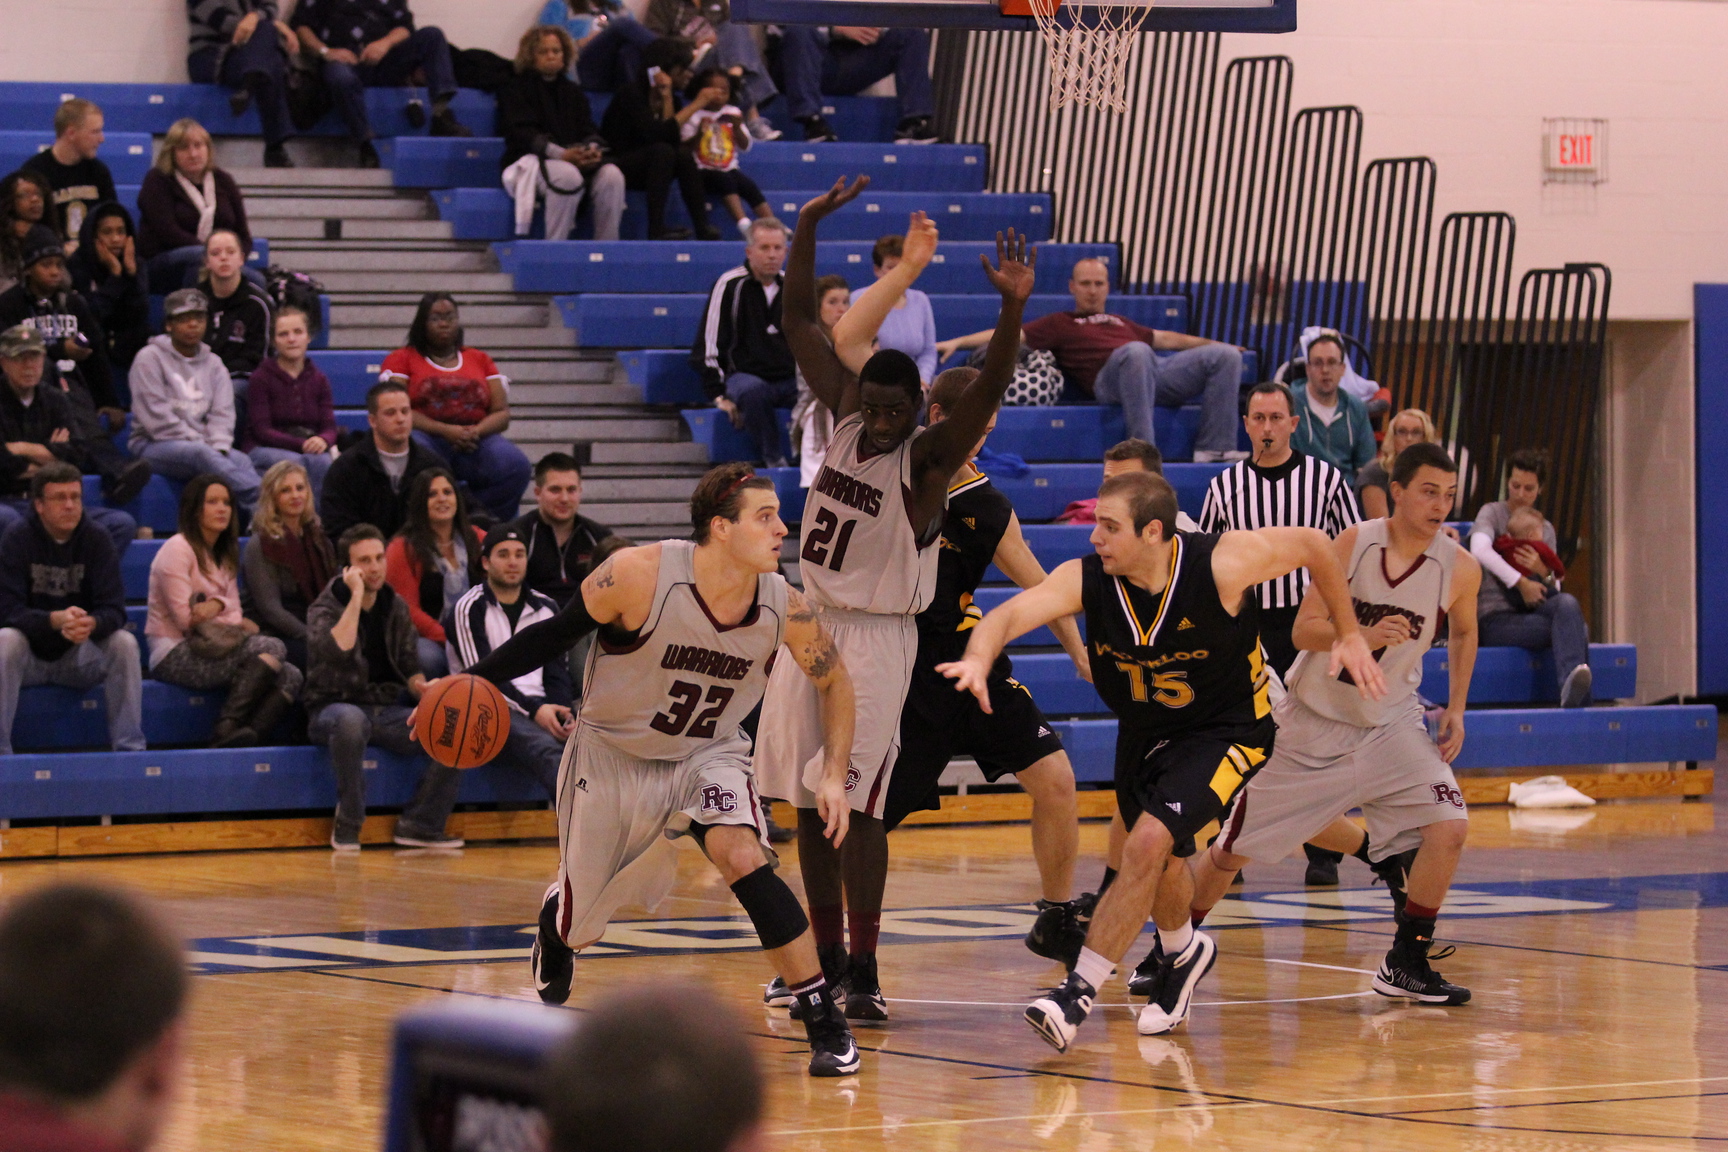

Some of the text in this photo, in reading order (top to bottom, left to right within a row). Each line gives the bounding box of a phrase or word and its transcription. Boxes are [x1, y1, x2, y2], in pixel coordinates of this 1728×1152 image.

[1560, 135, 1592, 165] EXIT
[801, 506, 858, 572] 21
[1352, 597, 1426, 640] ARRRS
[661, 644, 754, 681] WARRIORS
[1095, 641, 1209, 669] WRLOO
[1115, 661, 1195, 709] 15
[649, 680, 735, 739] 32
[701, 783, 738, 813] RC
[1430, 782, 1465, 810] RC
